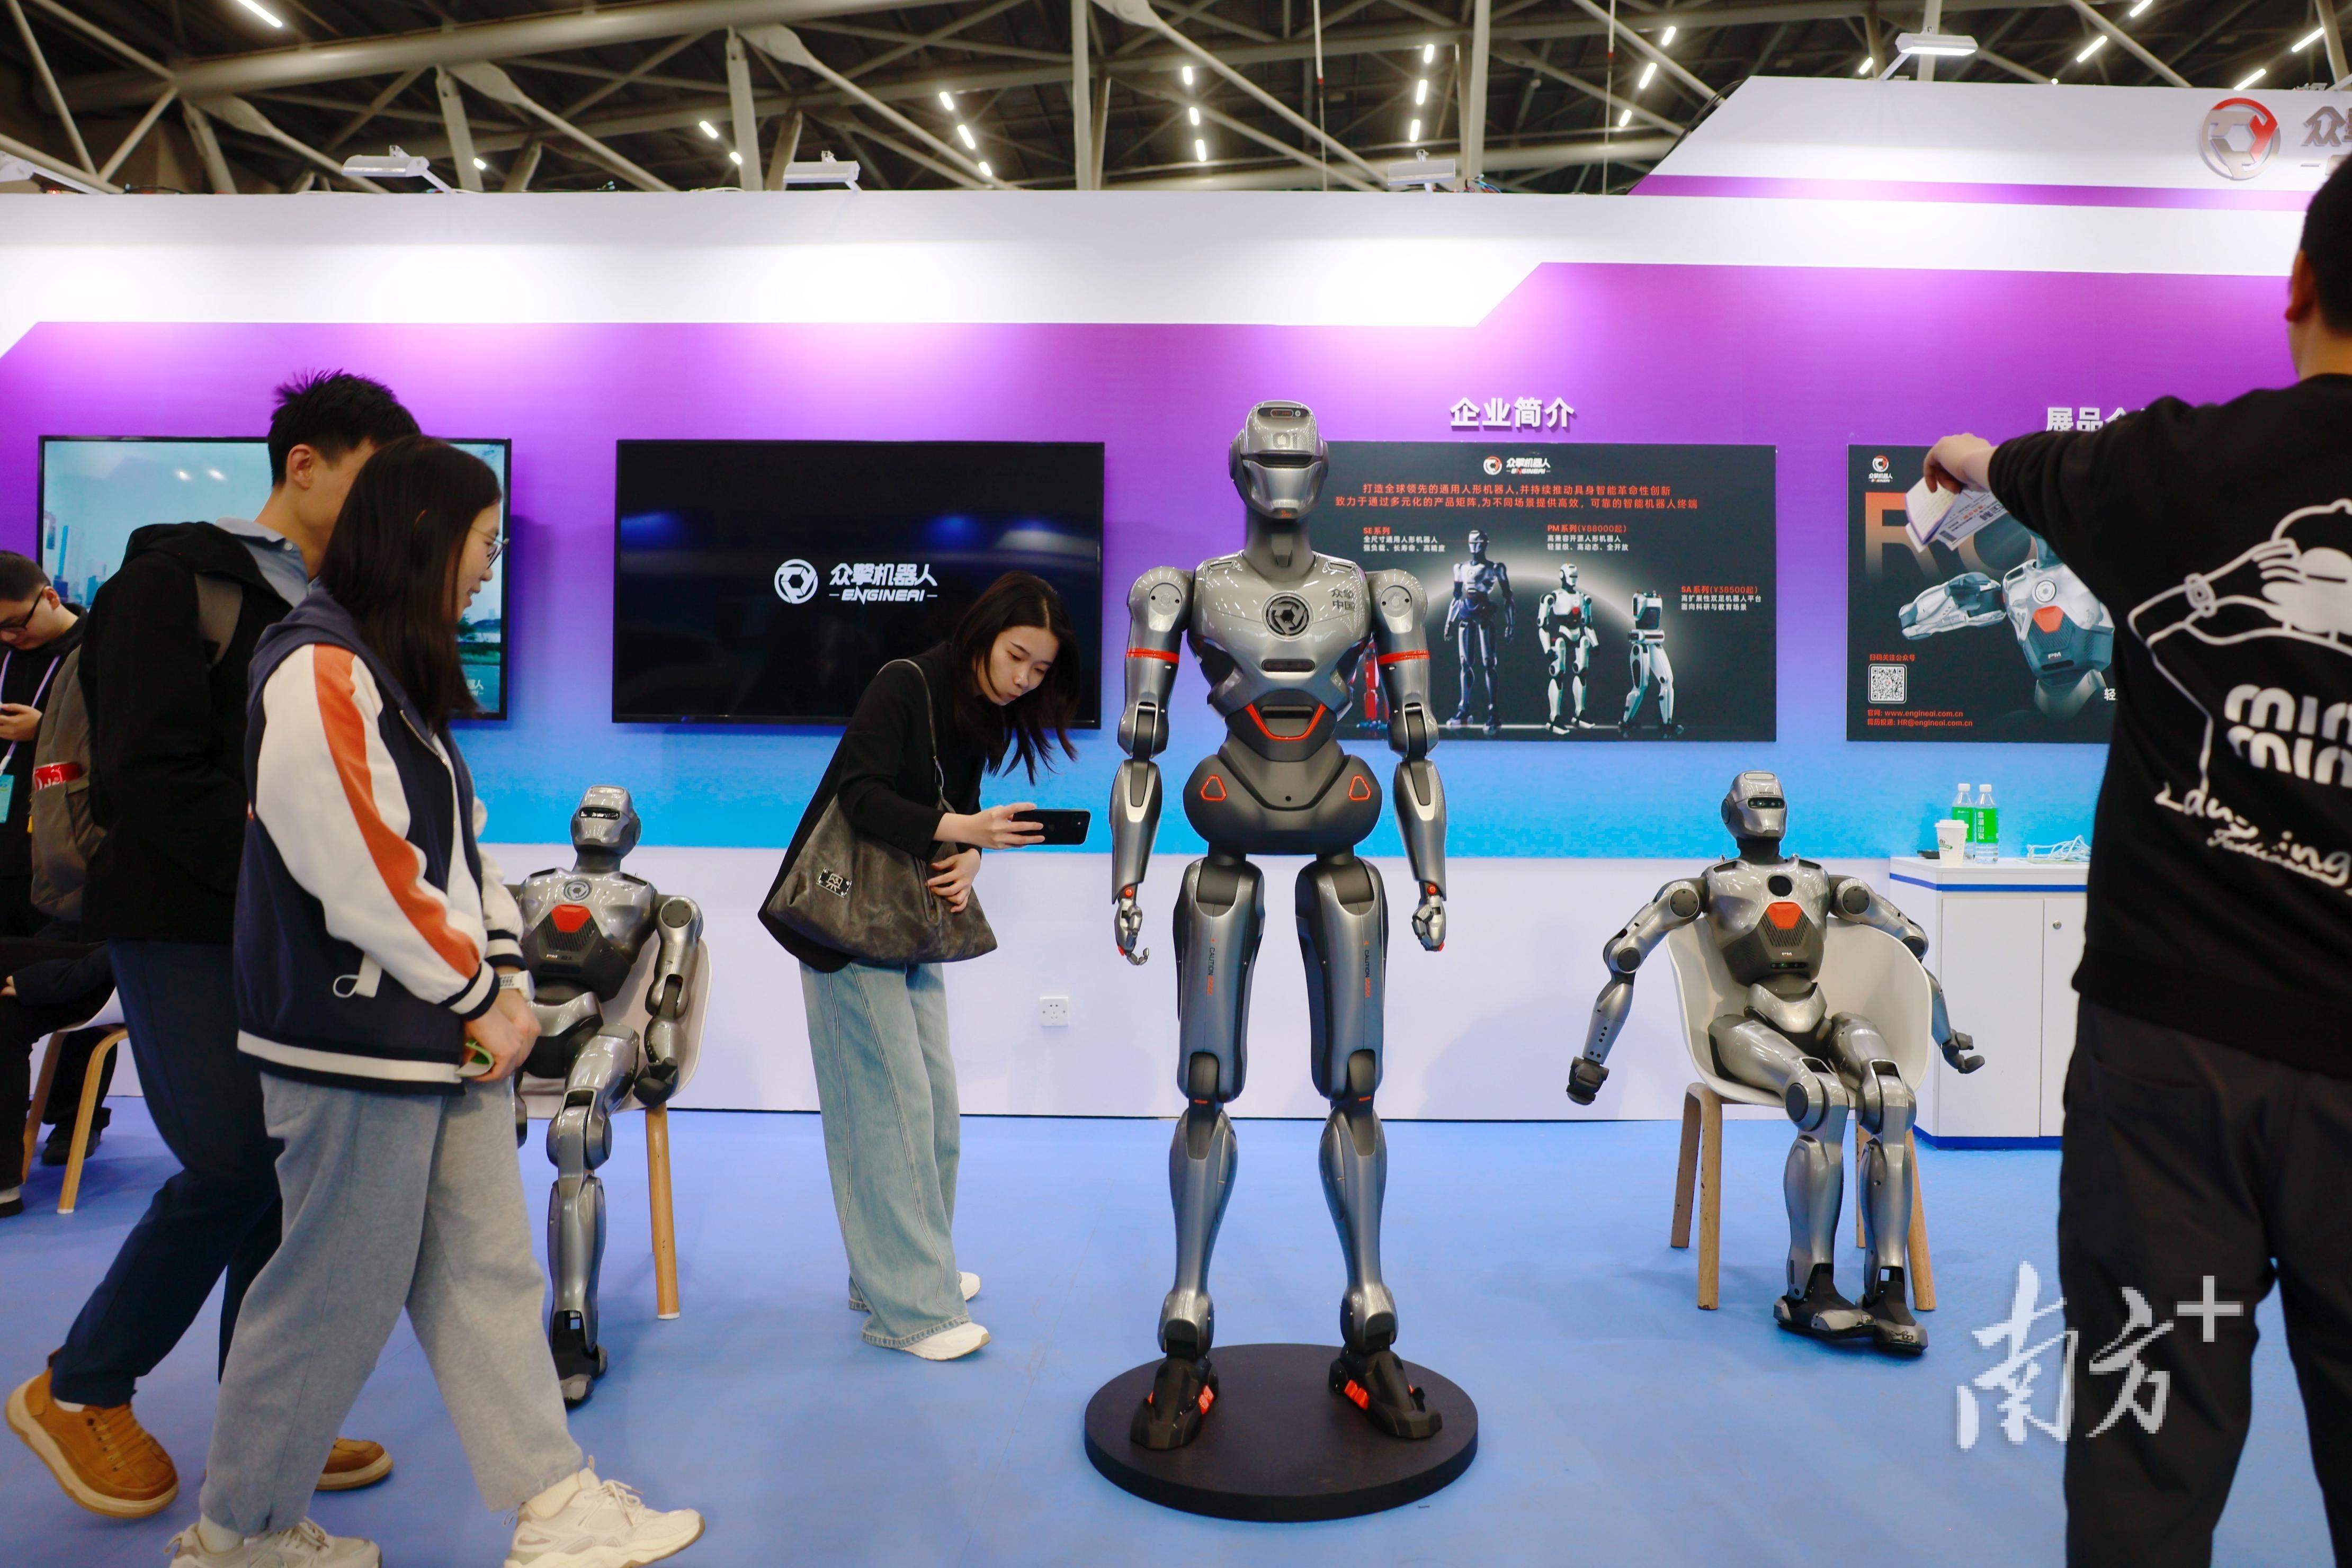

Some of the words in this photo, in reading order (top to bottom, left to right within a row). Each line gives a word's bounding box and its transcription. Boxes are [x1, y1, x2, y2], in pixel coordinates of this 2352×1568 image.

[2302, 106, 2352, 147] 众
[1450, 397, 1575, 427] 企业简介
[2046, 407, 2145, 432] 展品
[1506, 458, 1551, 468] 众擎机器人
[829, 562, 938, 586] 众擎机器人
[841, 586, 925, 605] ENGINEAI
[2104, 687, 2118, 701] 轻
[1885, 710, 1963, 718] www.engineai.com.cn
[1898, 719, 1973, 728] HR@engineai.com.cn
